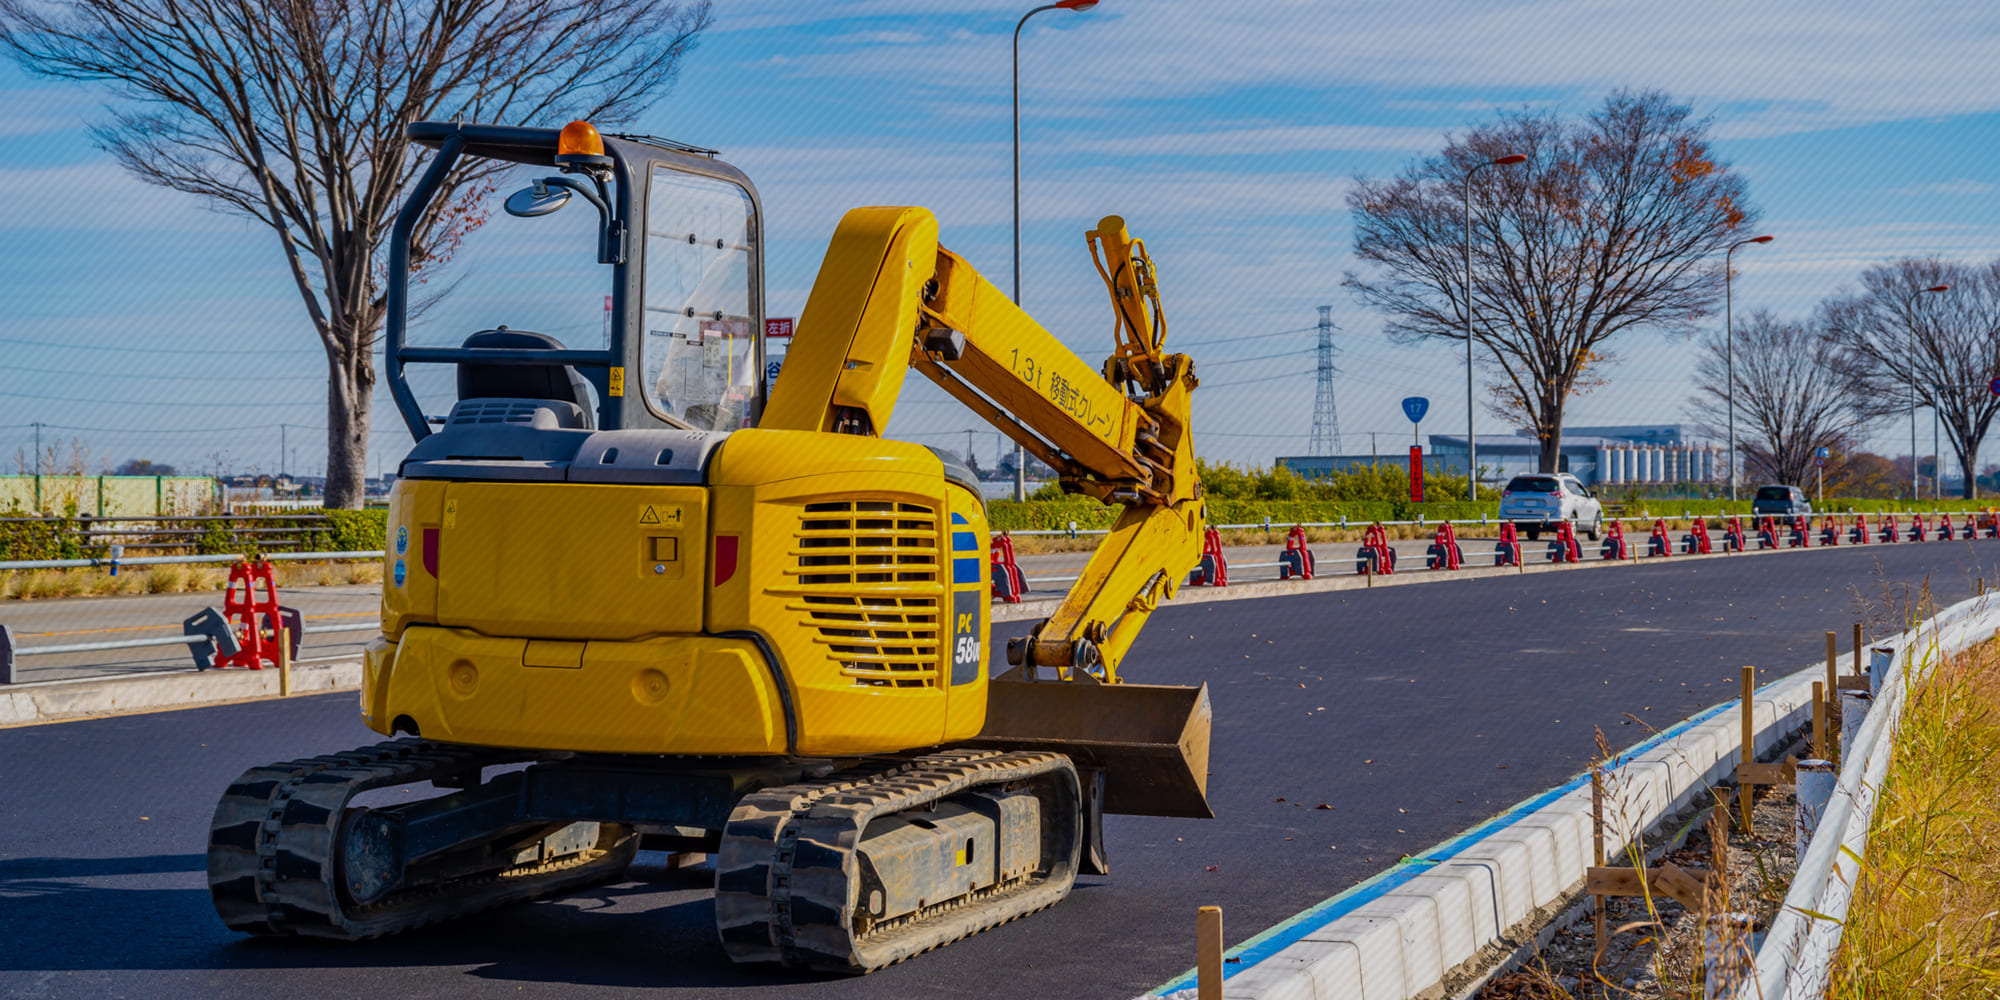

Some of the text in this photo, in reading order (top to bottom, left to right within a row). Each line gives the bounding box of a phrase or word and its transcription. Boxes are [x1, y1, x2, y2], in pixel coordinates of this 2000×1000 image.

[768, 321, 790, 334] 左折
[1050, 371, 1115, 437] 移動式クレーン
[1410, 403, 1422, 414] 17
[957, 612, 973, 634] PC
